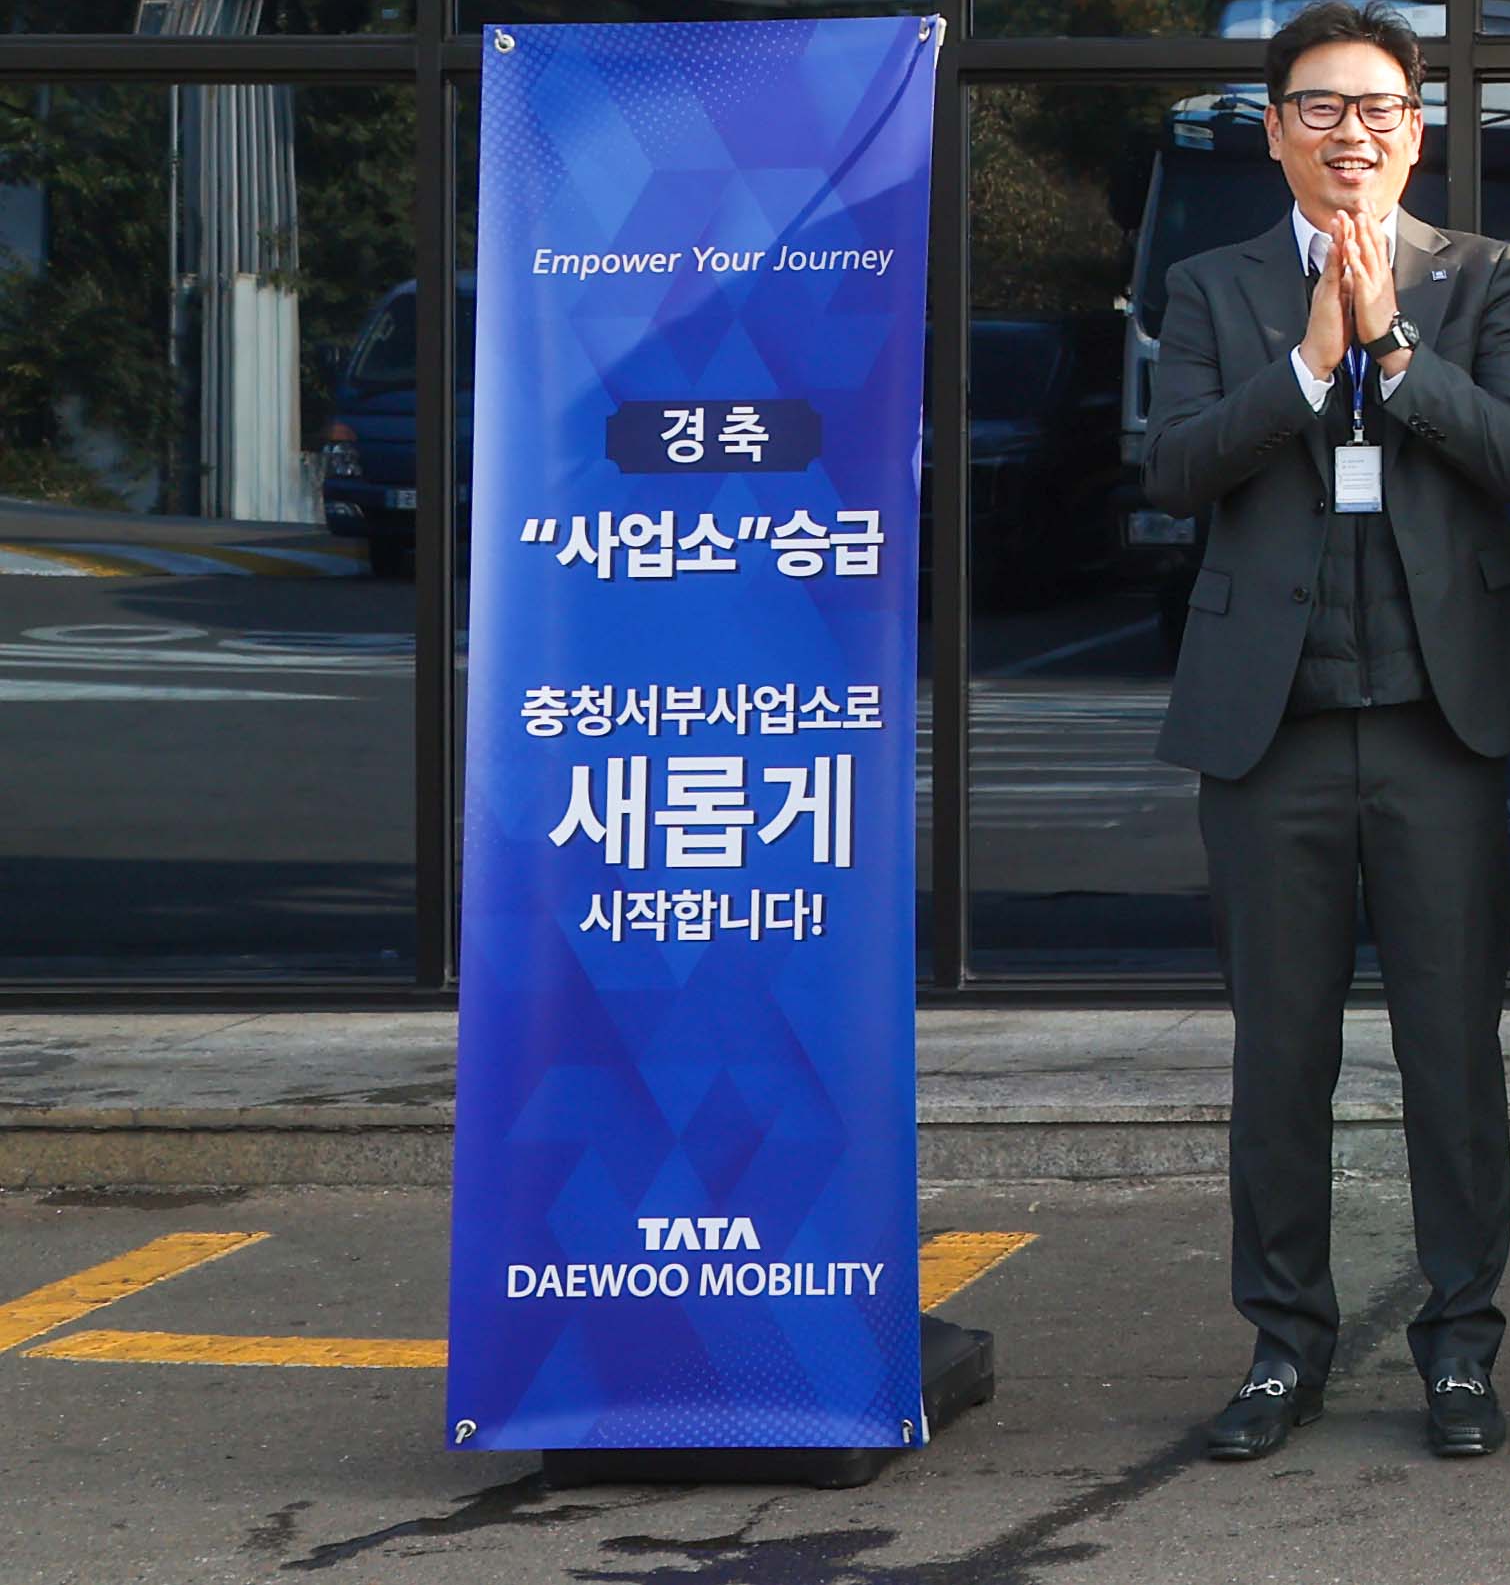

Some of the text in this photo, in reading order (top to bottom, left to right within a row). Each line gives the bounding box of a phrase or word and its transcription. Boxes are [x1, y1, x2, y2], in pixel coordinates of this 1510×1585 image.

[532, 244, 894, 281] Empower Your Journey
[660, 406, 769, 464] 경축
[520, 683, 883, 737] 충청서부사업소로
[548, 754, 853, 870] 새롭게
[579, 888, 824, 943] 시작합니다!
[638, 1217, 761, 1251] TATA
[506, 1261, 885, 1298] DAEWOO MOBILITY
